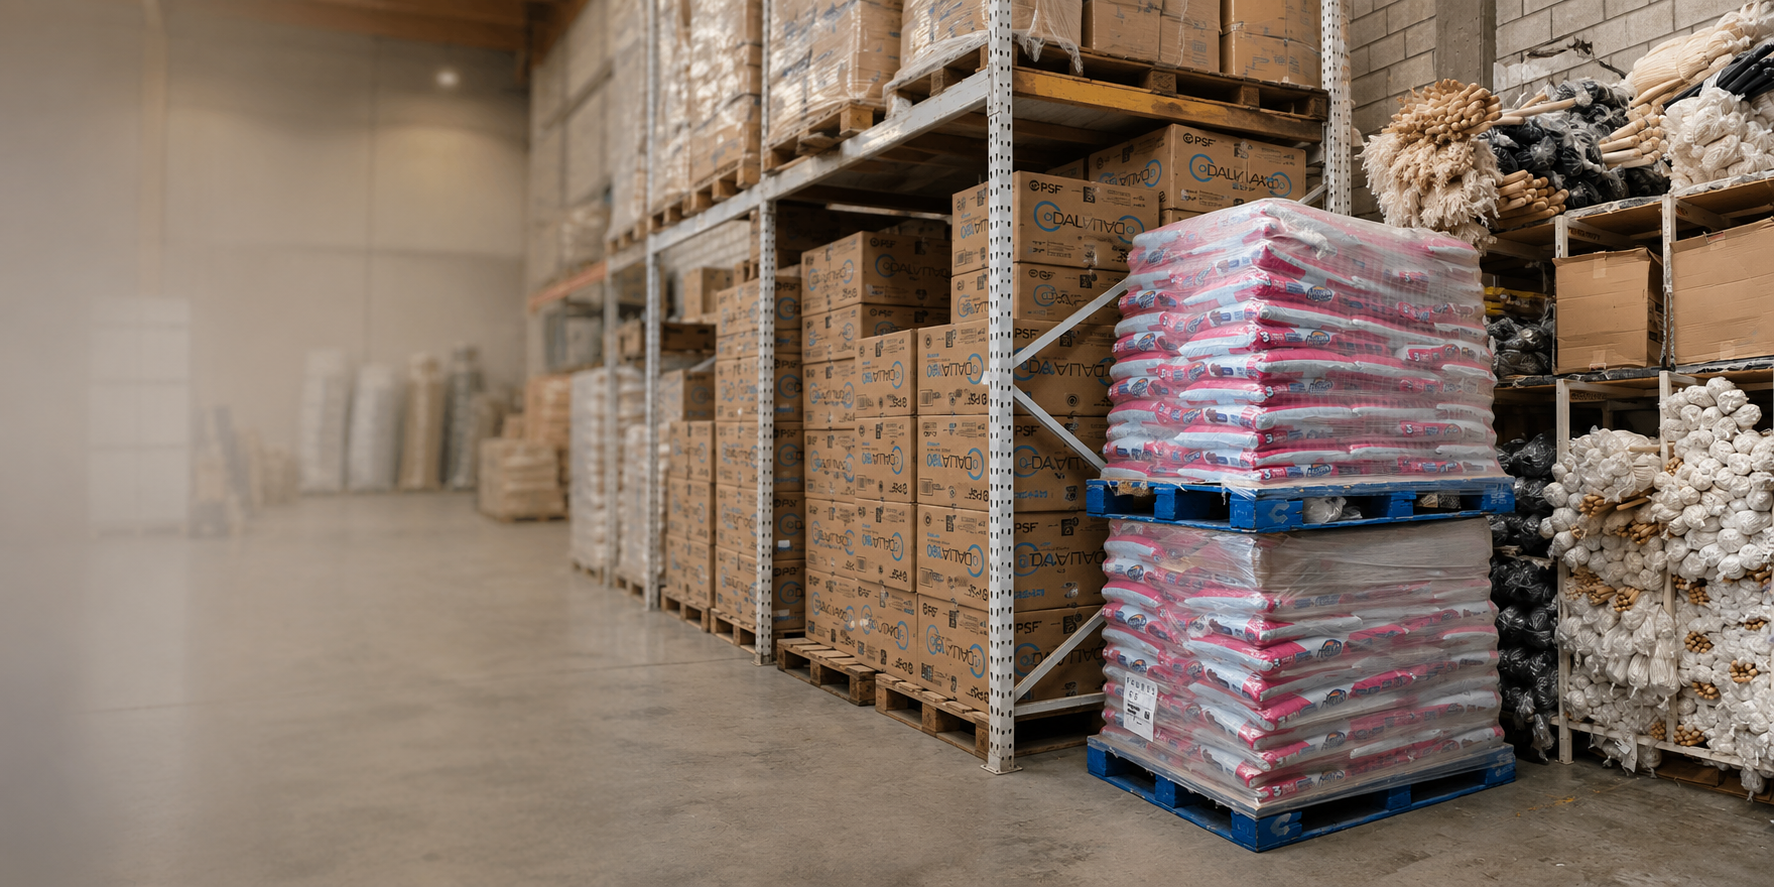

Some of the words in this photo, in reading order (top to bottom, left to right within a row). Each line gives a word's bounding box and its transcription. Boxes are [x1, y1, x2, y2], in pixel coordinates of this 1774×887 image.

[1194, 136, 1216, 147] PSF
[1041, 182, 1063, 195] PSF
[1015, 328, 1039, 339] PSF
[1015, 425, 1040, 436] PSF
[1265, 433, 1273, 444] 3
[1016, 620, 1042, 634] PSF
[1272, 785, 1282, 797] 3
